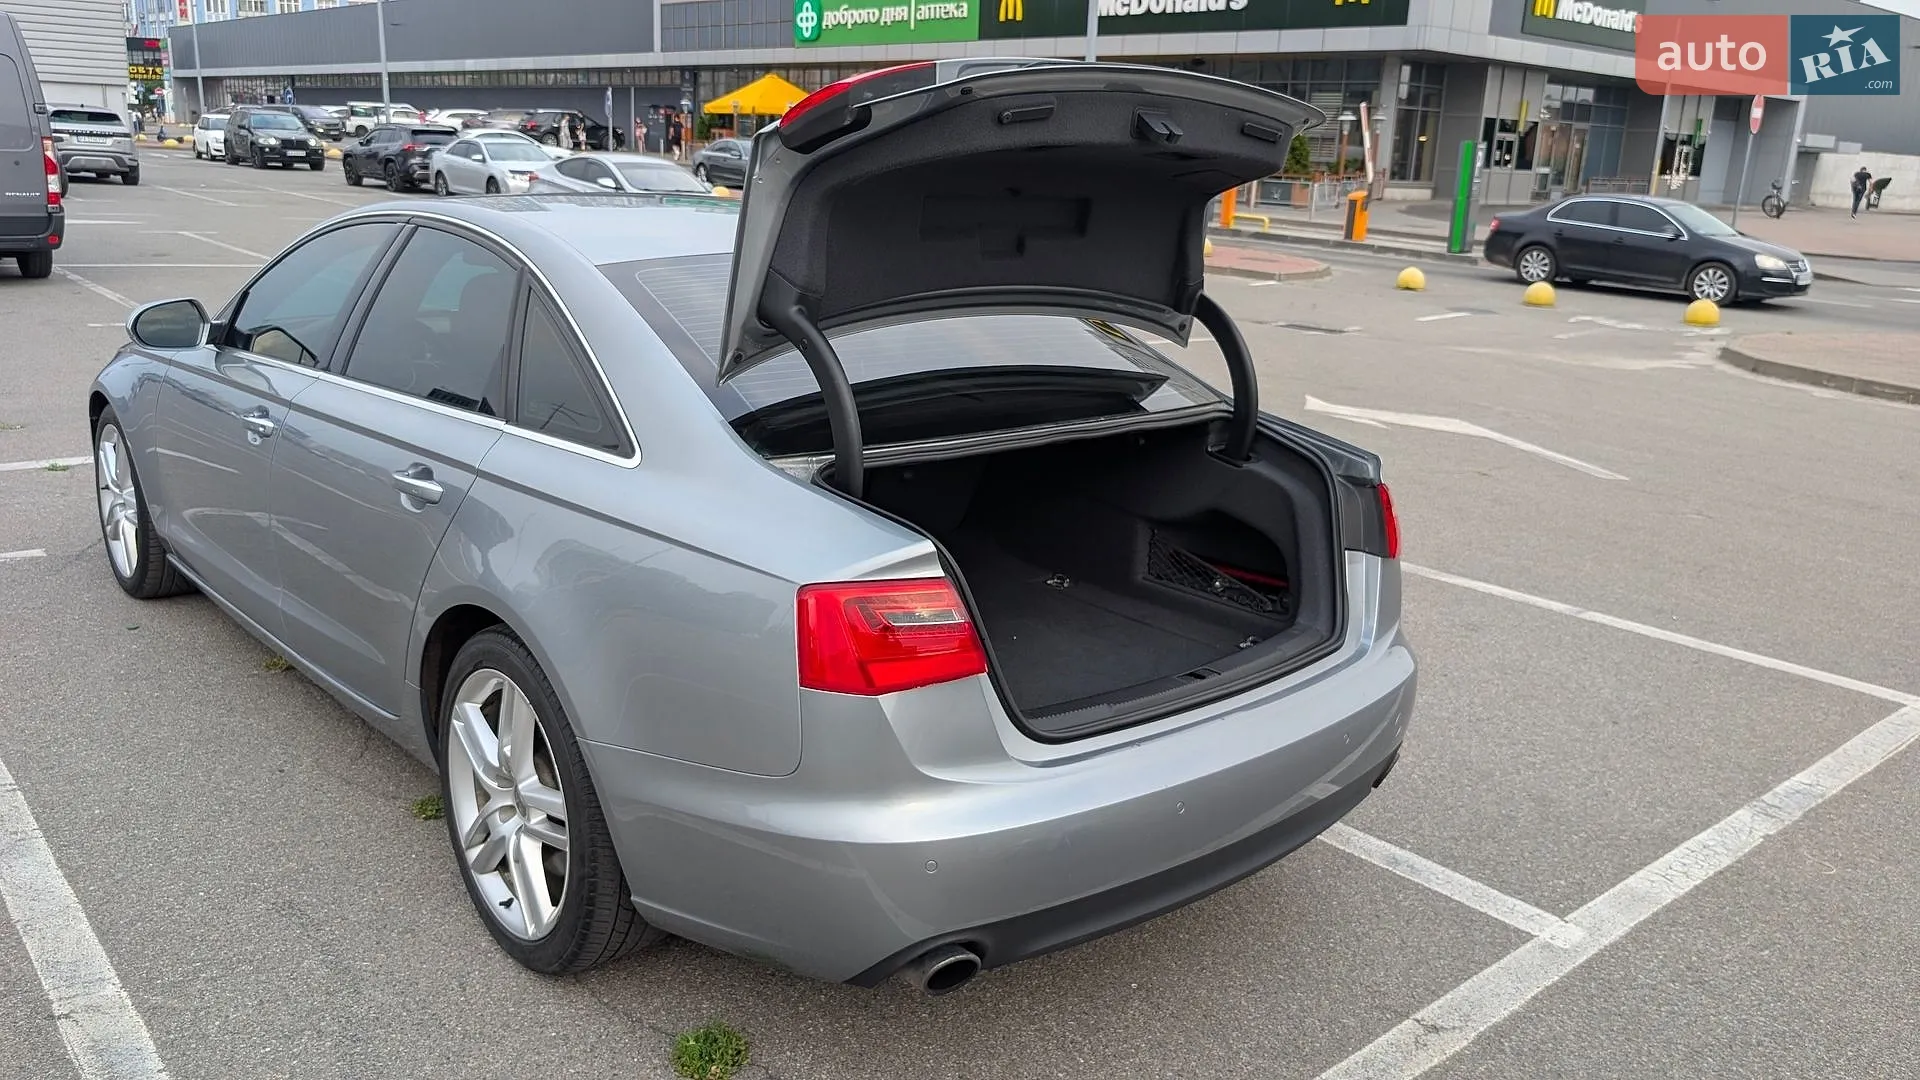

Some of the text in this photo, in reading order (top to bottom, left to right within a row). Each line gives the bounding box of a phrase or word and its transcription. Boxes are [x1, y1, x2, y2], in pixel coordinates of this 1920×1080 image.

[822, 1, 968, 30] доброго дня аптека
